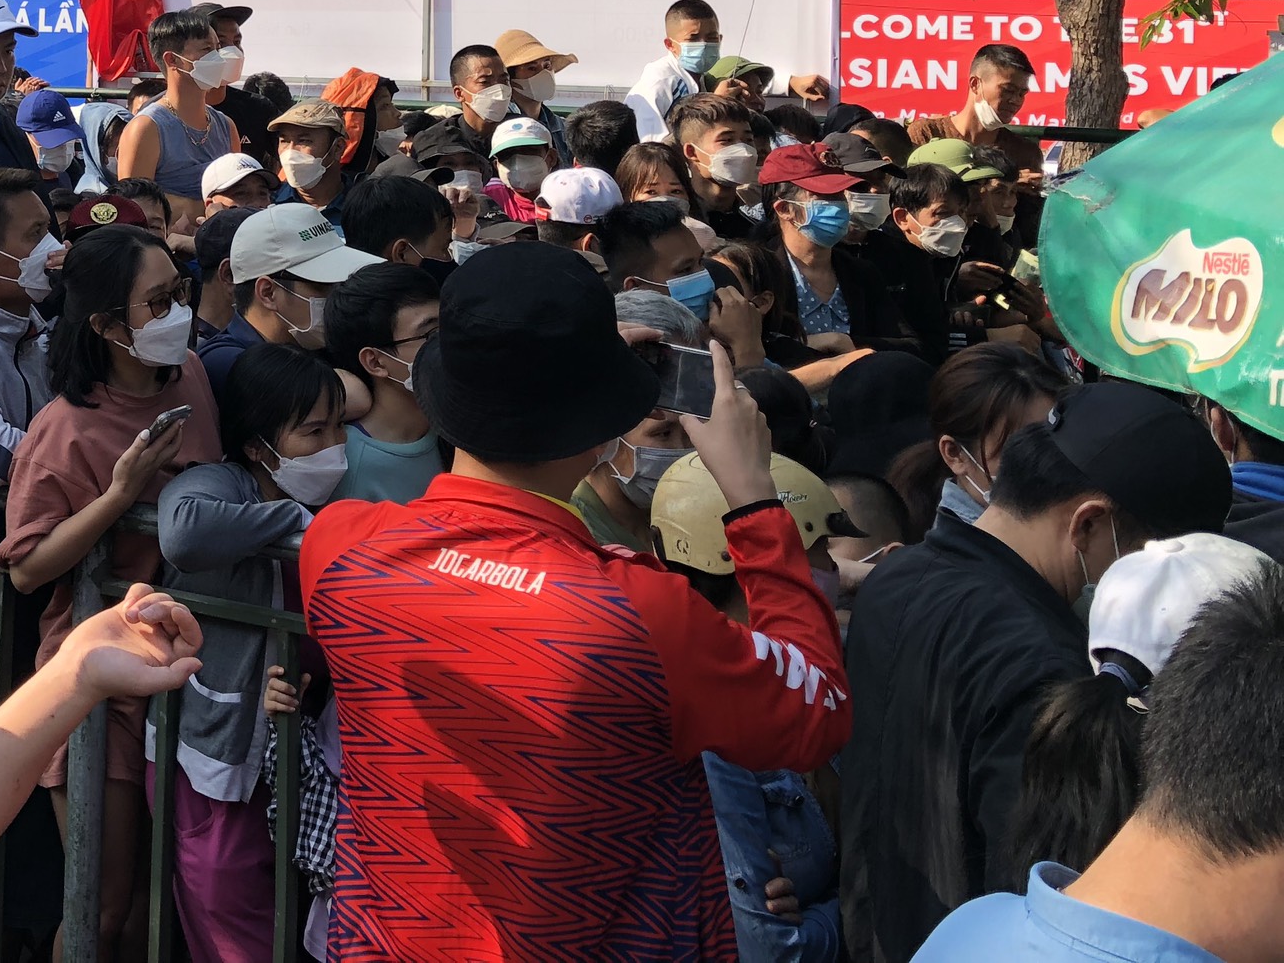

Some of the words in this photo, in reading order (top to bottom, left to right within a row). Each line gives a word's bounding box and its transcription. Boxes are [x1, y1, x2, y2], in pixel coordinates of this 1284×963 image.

[984, 15, 1043, 42] TO
[841, 58, 957, 90] SIAN
[1131, 269, 1248, 334] MILO
